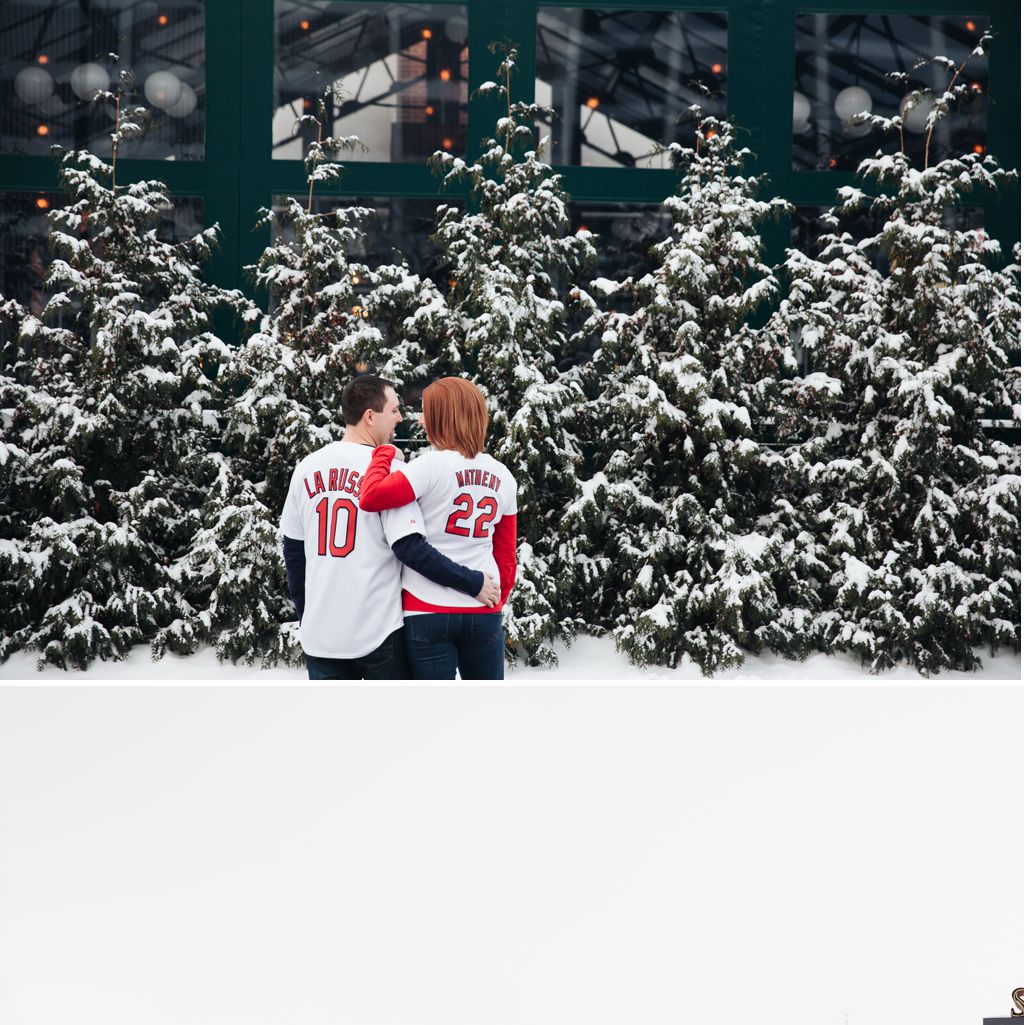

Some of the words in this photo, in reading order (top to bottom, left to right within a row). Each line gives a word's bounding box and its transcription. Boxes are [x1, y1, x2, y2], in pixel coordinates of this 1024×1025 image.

[304, 470, 326, 499] LA
[316, 496, 358, 558] 10
[445, 492, 498, 538] 22
